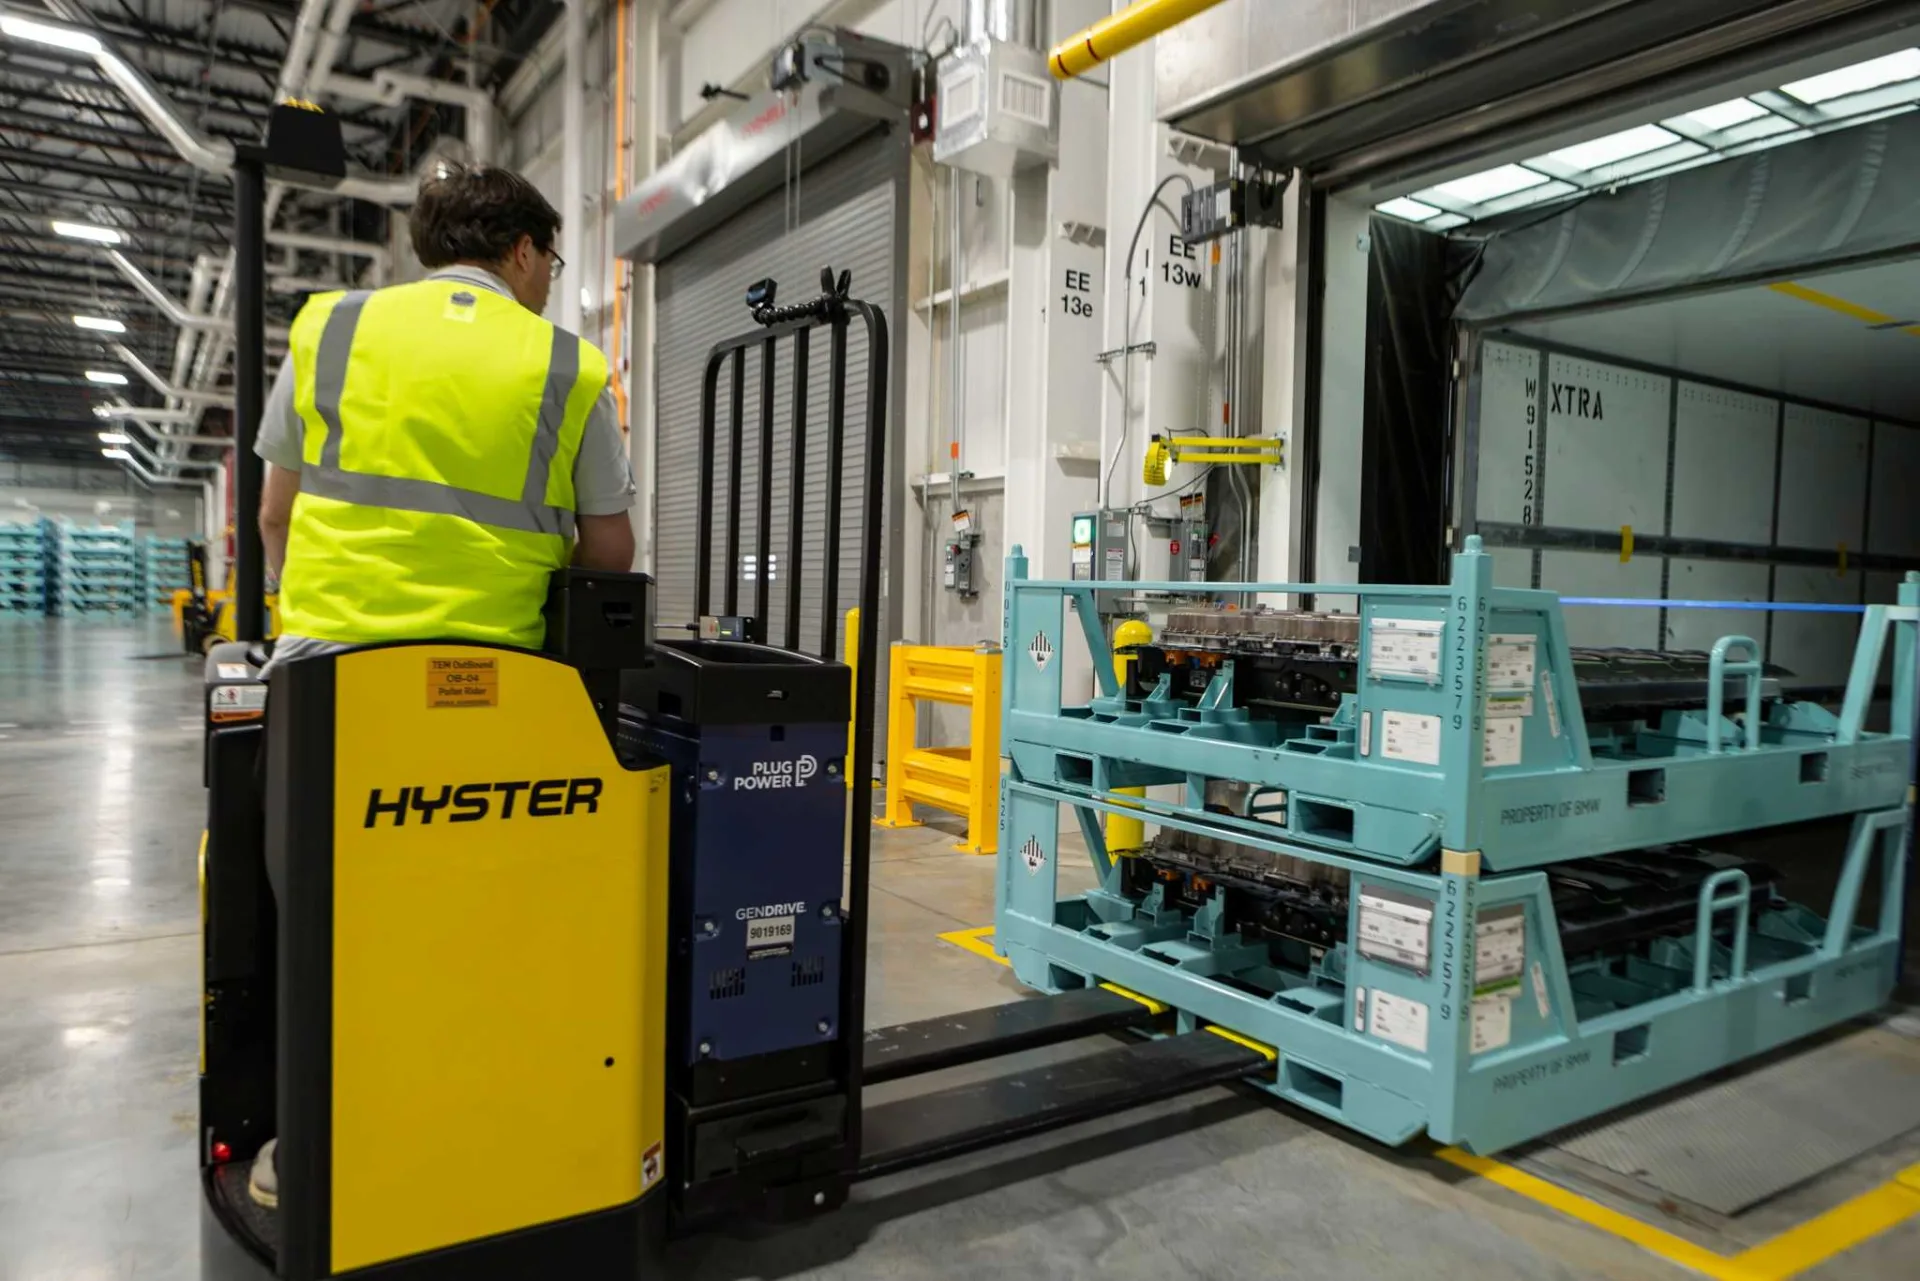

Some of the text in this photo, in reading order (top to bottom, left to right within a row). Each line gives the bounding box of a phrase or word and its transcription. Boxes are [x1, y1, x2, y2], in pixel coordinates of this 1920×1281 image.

[1169, 233, 1196, 260] EE
[1065, 269, 1091, 292] EE
[1161, 261, 1201, 289] 13w
[1061, 294, 1093, 318] 13e
[1551, 382, 1603, 421] XTRA
[1453, 596, 1468, 730] 6223579
[752, 761, 793, 776] PLUG
[734, 774, 792, 791] POWER
[363, 777, 603, 829] HYSTER
[1500, 803, 1557, 825] PROPERTY
[1558, 800, 1574, 818] OF
[735, 901, 807, 920] GENDRIVE
[749, 923, 793, 940] 9019169
